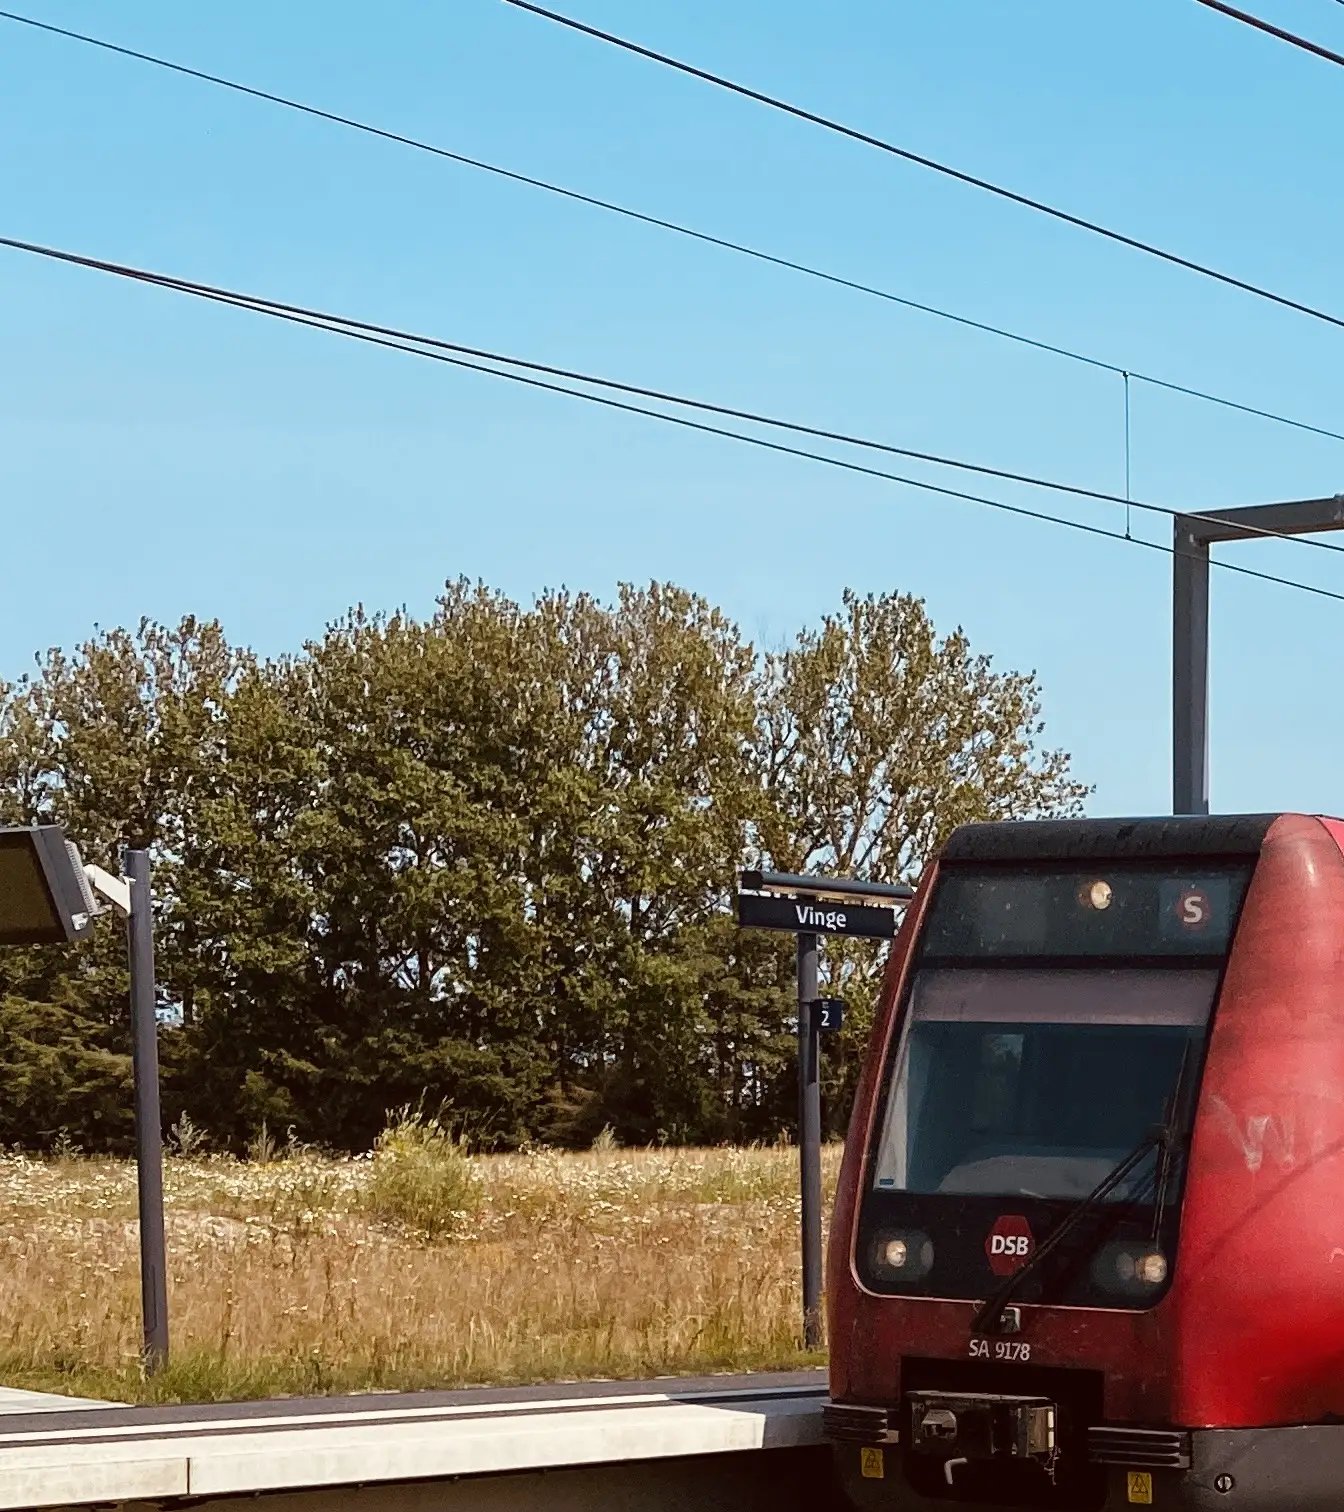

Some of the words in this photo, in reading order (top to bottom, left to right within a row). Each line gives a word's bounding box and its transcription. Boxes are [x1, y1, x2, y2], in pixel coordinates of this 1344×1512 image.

[795, 905, 847, 930] Vinge
[1183, 896, 1203, 923] S
[821, 1010, 830, 1026] 2
[991, 1235, 1029, 1256] DSB
[969, 1339, 990, 1358] SA
[995, 1342, 1031, 1361] 9178
